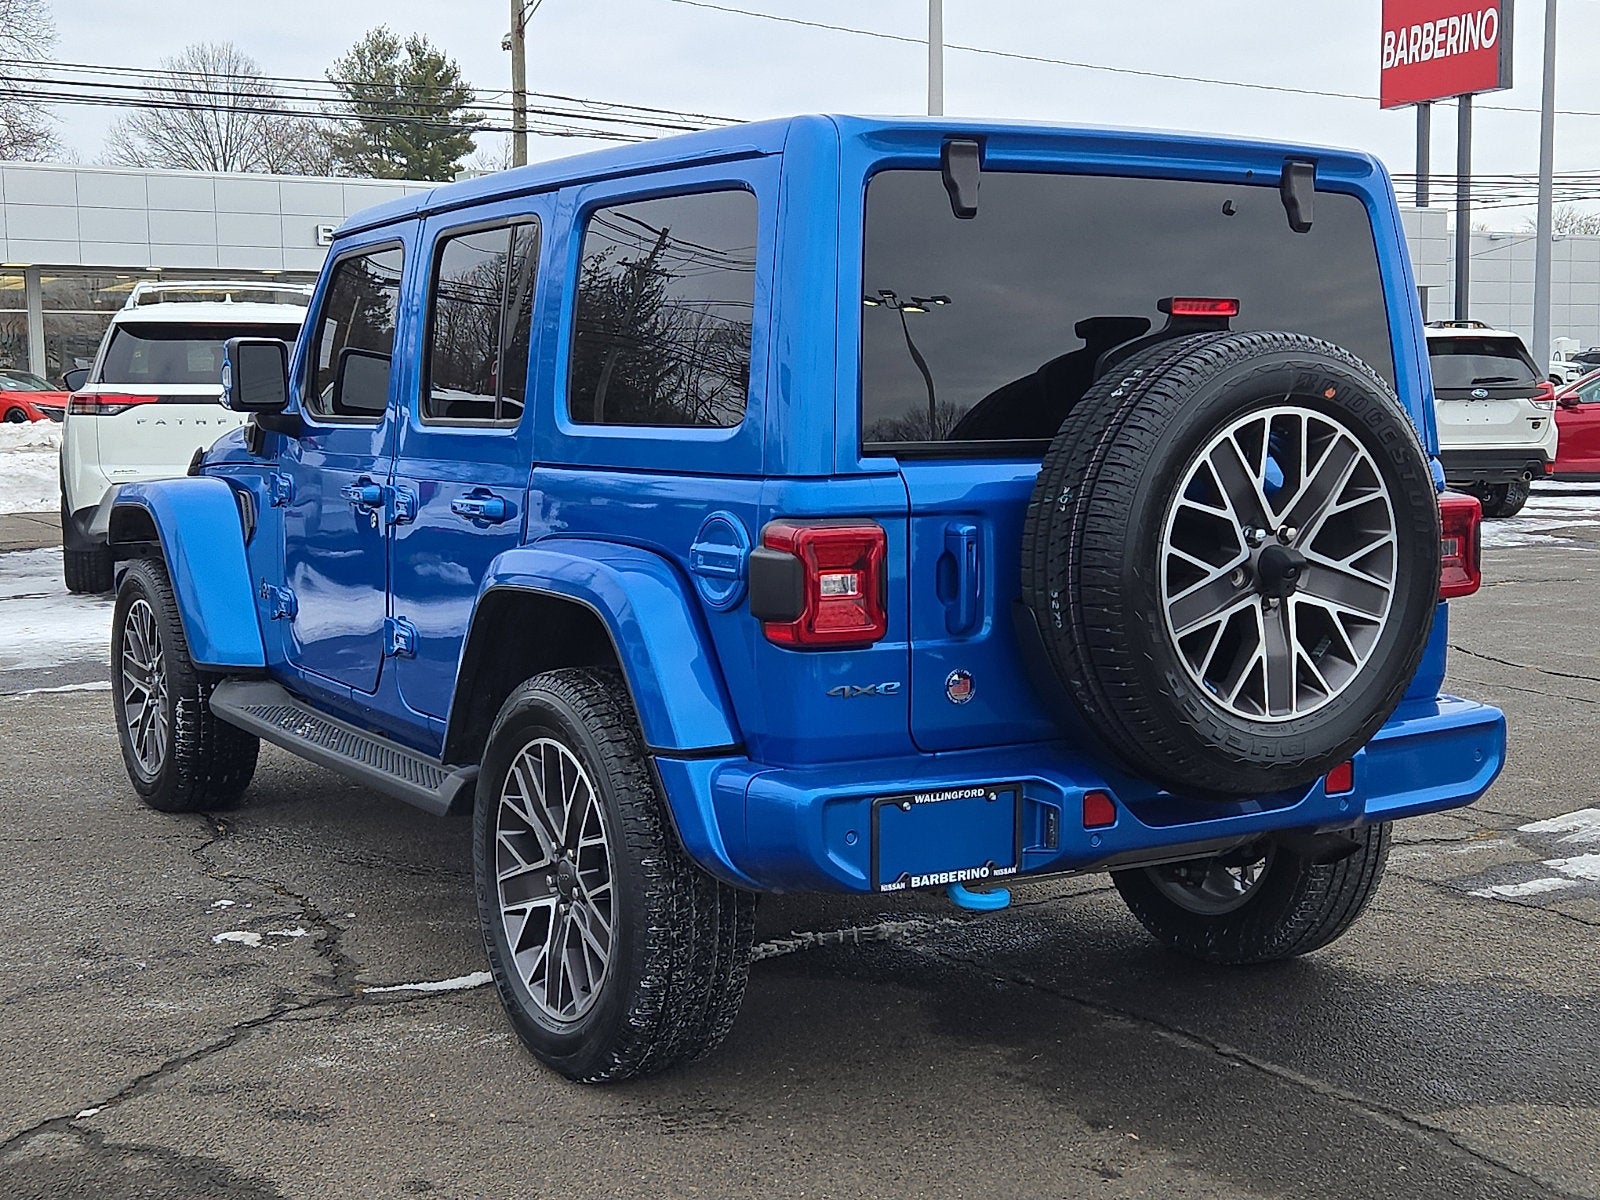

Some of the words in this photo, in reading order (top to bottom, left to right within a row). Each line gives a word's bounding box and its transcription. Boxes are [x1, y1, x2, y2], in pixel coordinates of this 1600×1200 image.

[1382, 7, 1499, 70] BARBERINO
[914, 788, 985, 804] WALLINGFORD
[880, 882, 906, 892] NISSAN
[910, 867, 990, 888] BARBERINO
[993, 867, 1017, 876] NISSAN
